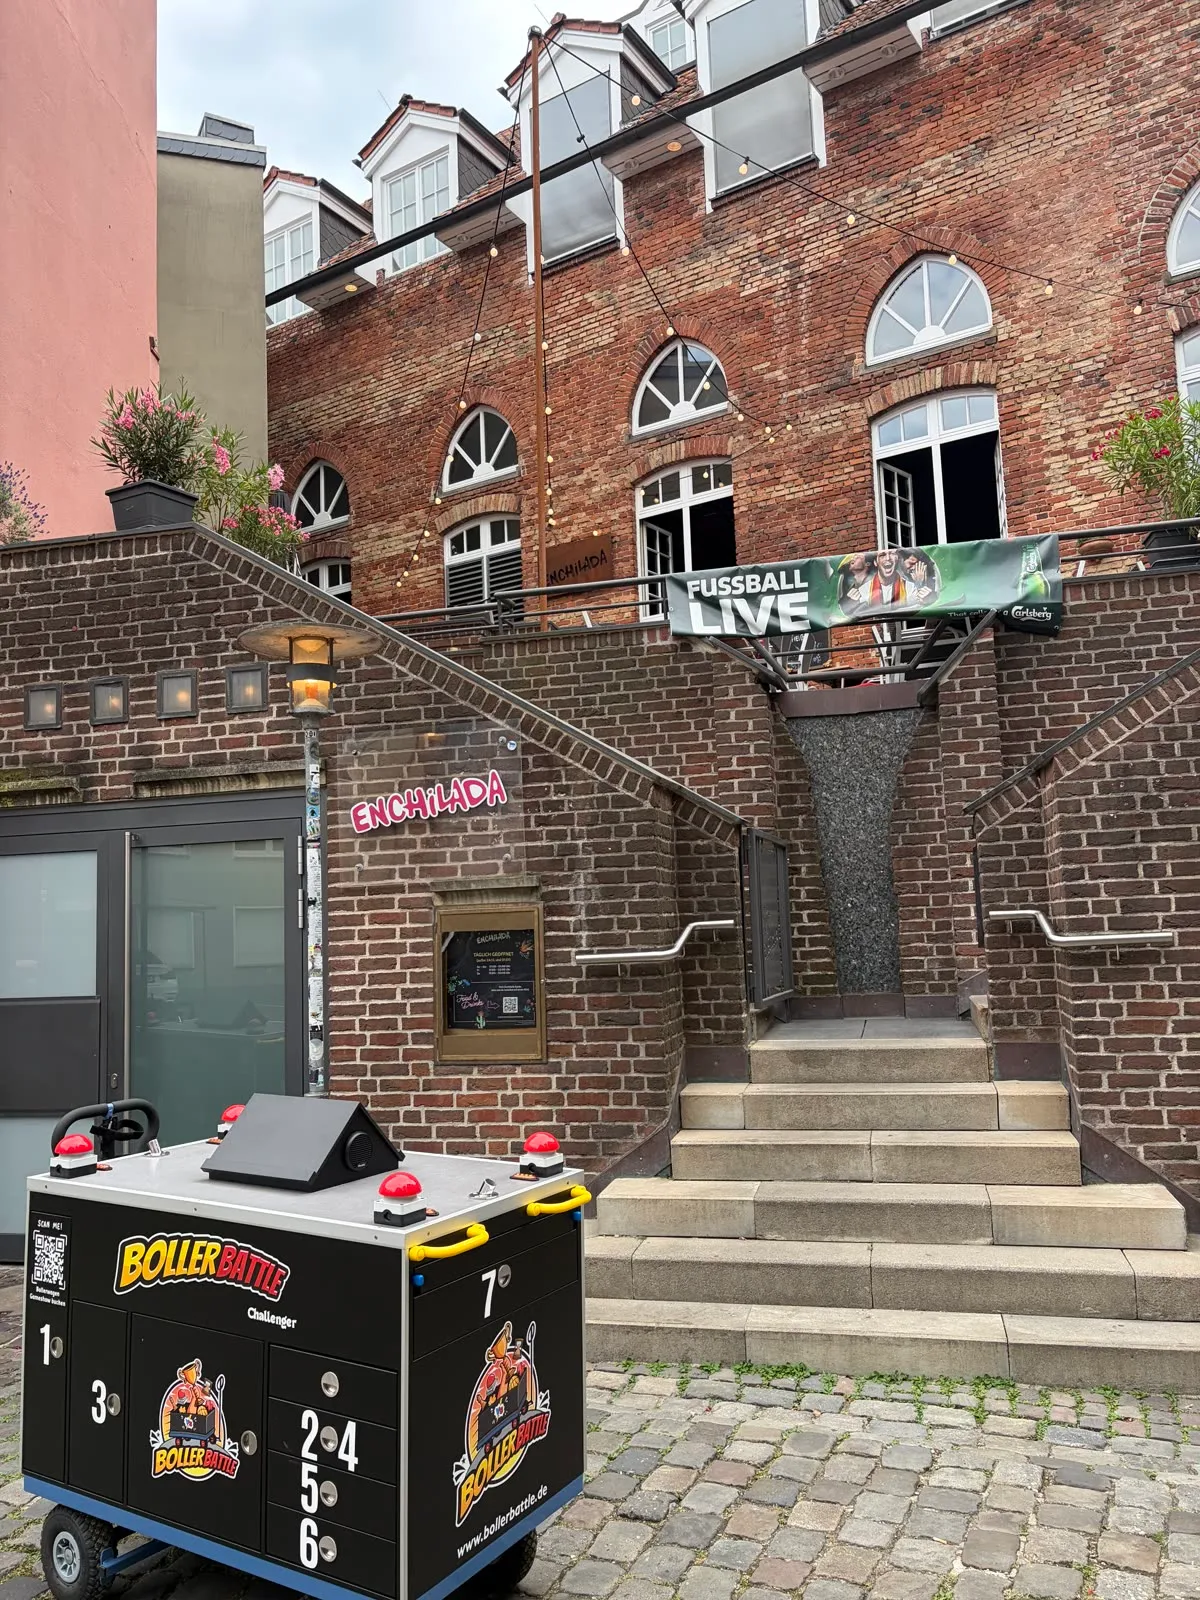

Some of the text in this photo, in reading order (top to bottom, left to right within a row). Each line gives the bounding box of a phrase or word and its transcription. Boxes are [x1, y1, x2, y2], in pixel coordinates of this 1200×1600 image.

[686, 569, 809, 599] FUSSBALL
[688, 592, 811, 636] LIVE
[1011, 605, 1052, 621] Carlsberg
[37, 1219, 63, 1231] SCAN ME!
[35, 1286, 60, 1297] Bollerwagen
[51, 1297, 66, 1307] buchen
[481, 1268, 497, 1319] 7
[247, 1306, 297, 1329] Challenger
[40, 1323, 51, 1366] 1
[91, 1379, 107, 1424] 3
[301, 1409, 359, 1473] 2 4
[300, 1461, 319, 1514] 5
[299, 1517, 319, 1569] 6
[456, 1484, 548, 1559] www.bollerbattle.de
